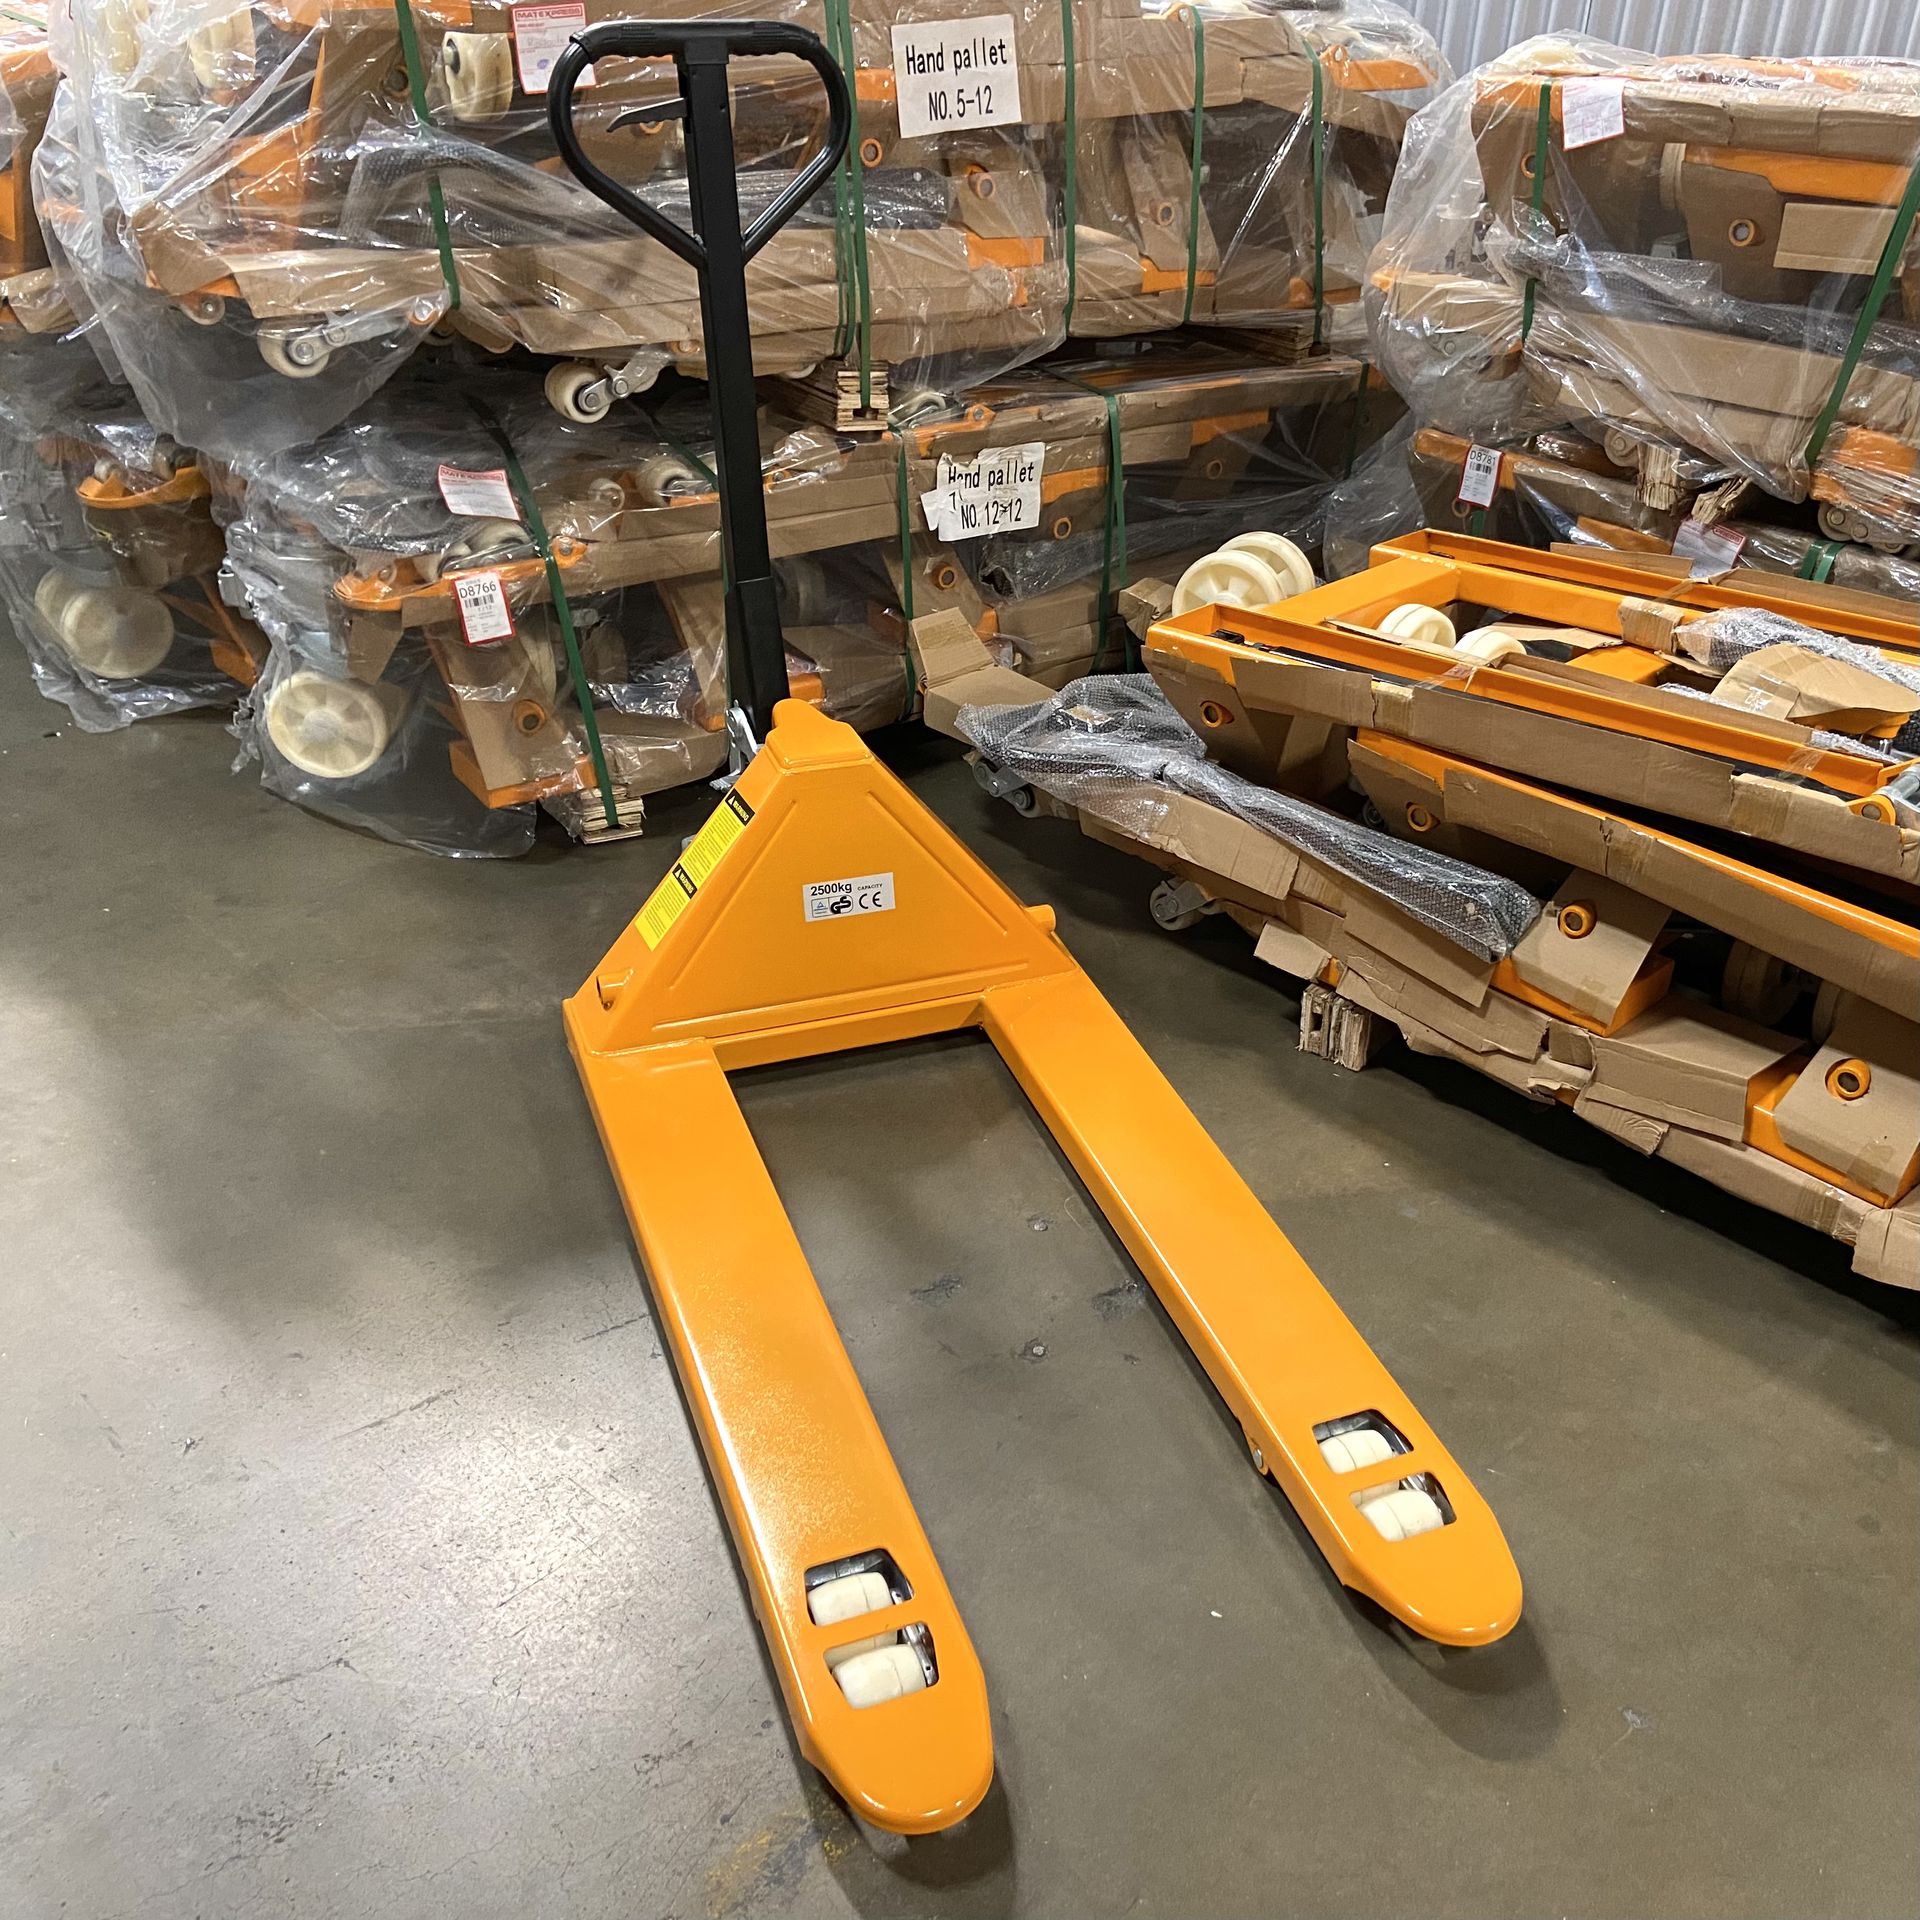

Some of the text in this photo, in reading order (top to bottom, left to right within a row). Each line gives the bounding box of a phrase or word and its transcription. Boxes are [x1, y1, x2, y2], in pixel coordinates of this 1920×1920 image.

[906, 37, 1007, 76] Hand pallet
[988, 460, 1035, 491] pallet
[459, 581, 497, 599] D8766
[810, 882, 883, 896] 2500kg CAPACITY
[858, 891, 882, 909] CE
